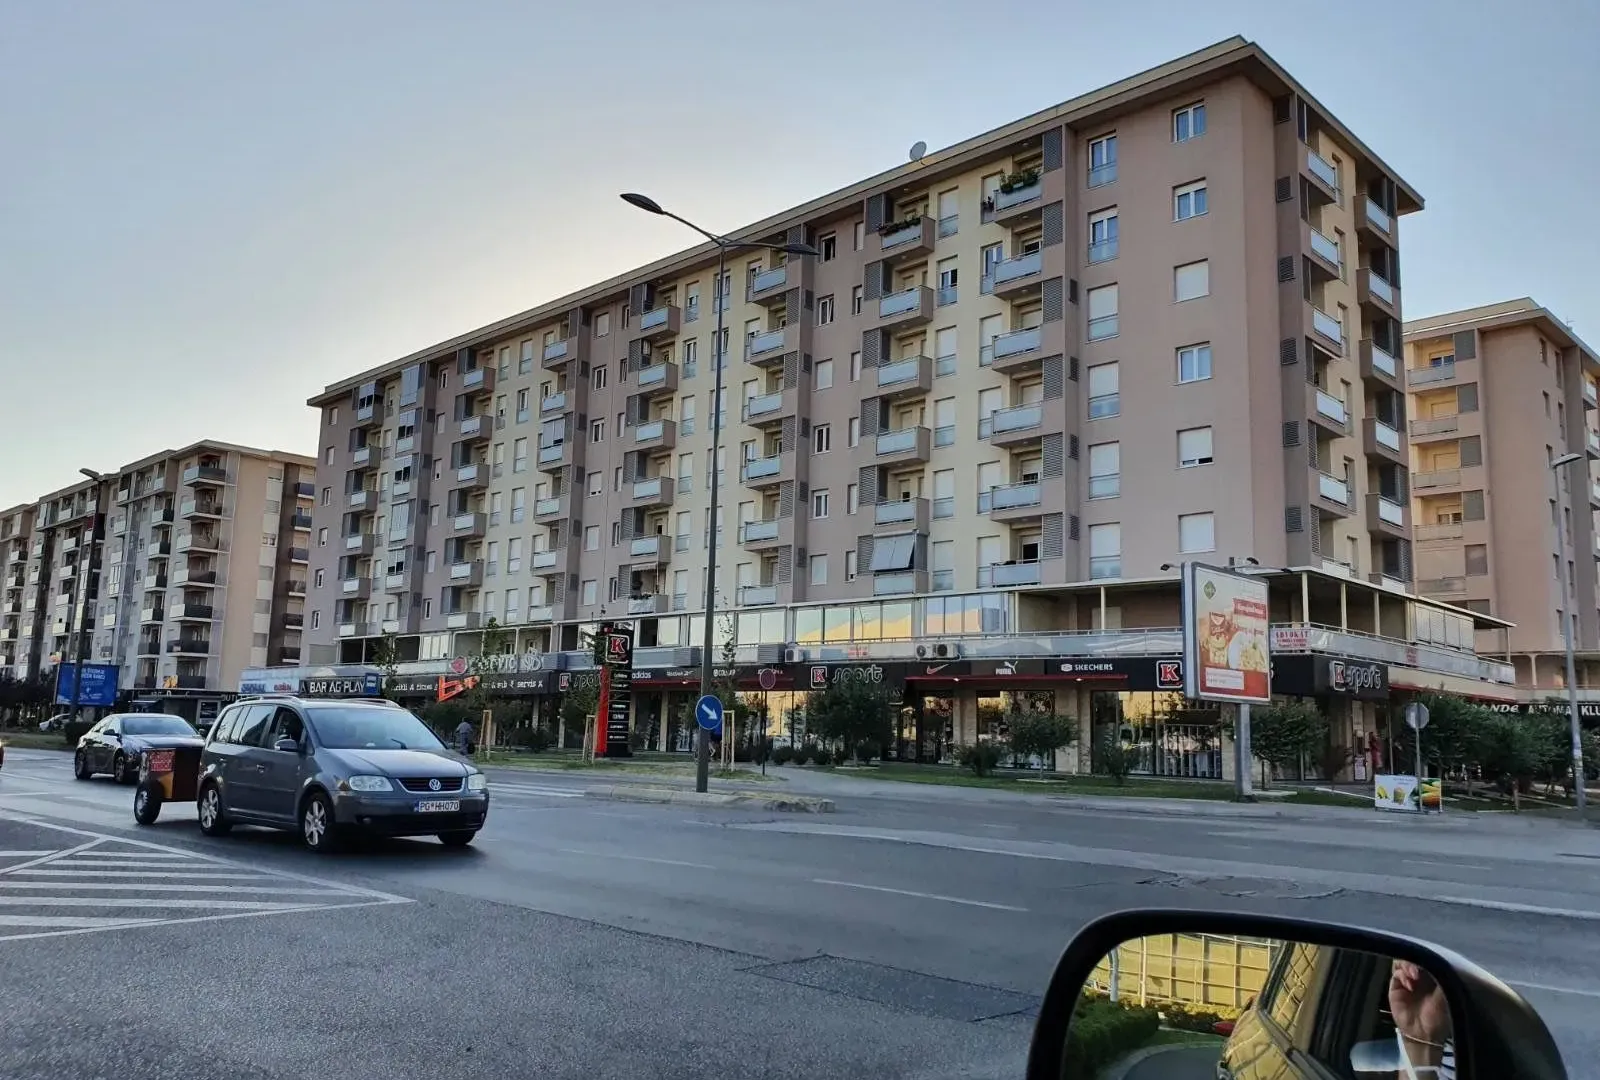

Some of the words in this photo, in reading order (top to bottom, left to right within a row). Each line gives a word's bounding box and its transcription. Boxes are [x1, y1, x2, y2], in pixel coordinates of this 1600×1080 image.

[1075, 663, 1113, 671] SKECHERS
[631, 671, 652, 679] adidas
[1160, 663, 1180, 682] K
[309, 681, 327, 693] BAR
[344, 681, 365, 693] PLAY
